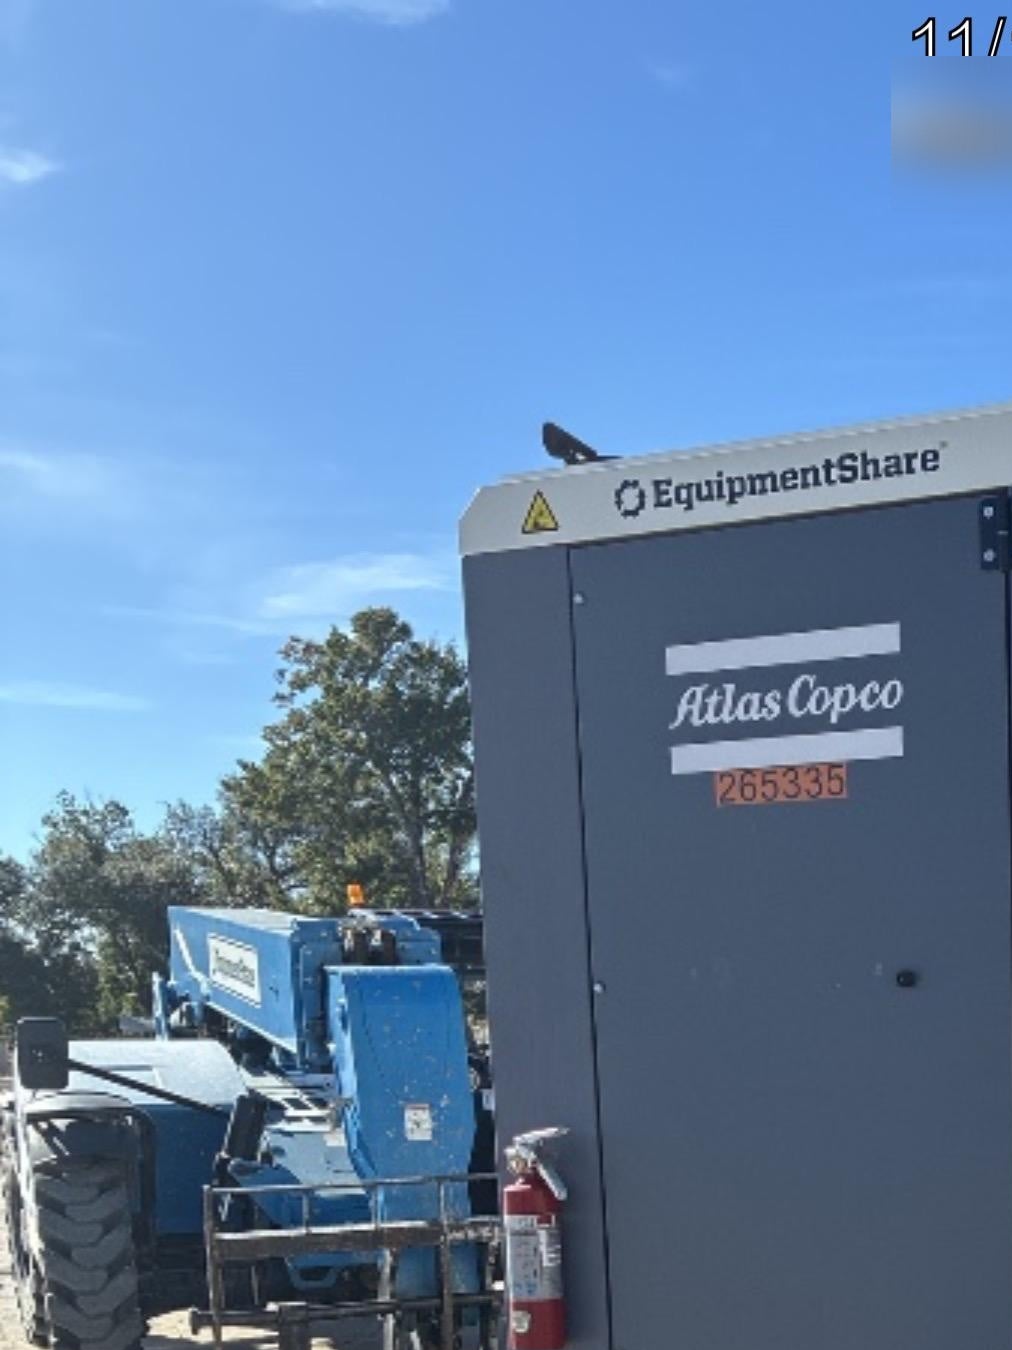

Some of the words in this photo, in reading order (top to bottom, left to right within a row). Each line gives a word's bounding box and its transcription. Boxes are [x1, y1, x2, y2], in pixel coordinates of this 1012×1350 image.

[652, 447, 941, 510] EquipmentShare
[668, 682, 782, 730] Atlas
[786, 673, 903, 724] Copco
[717, 763, 845, 804] 265335
